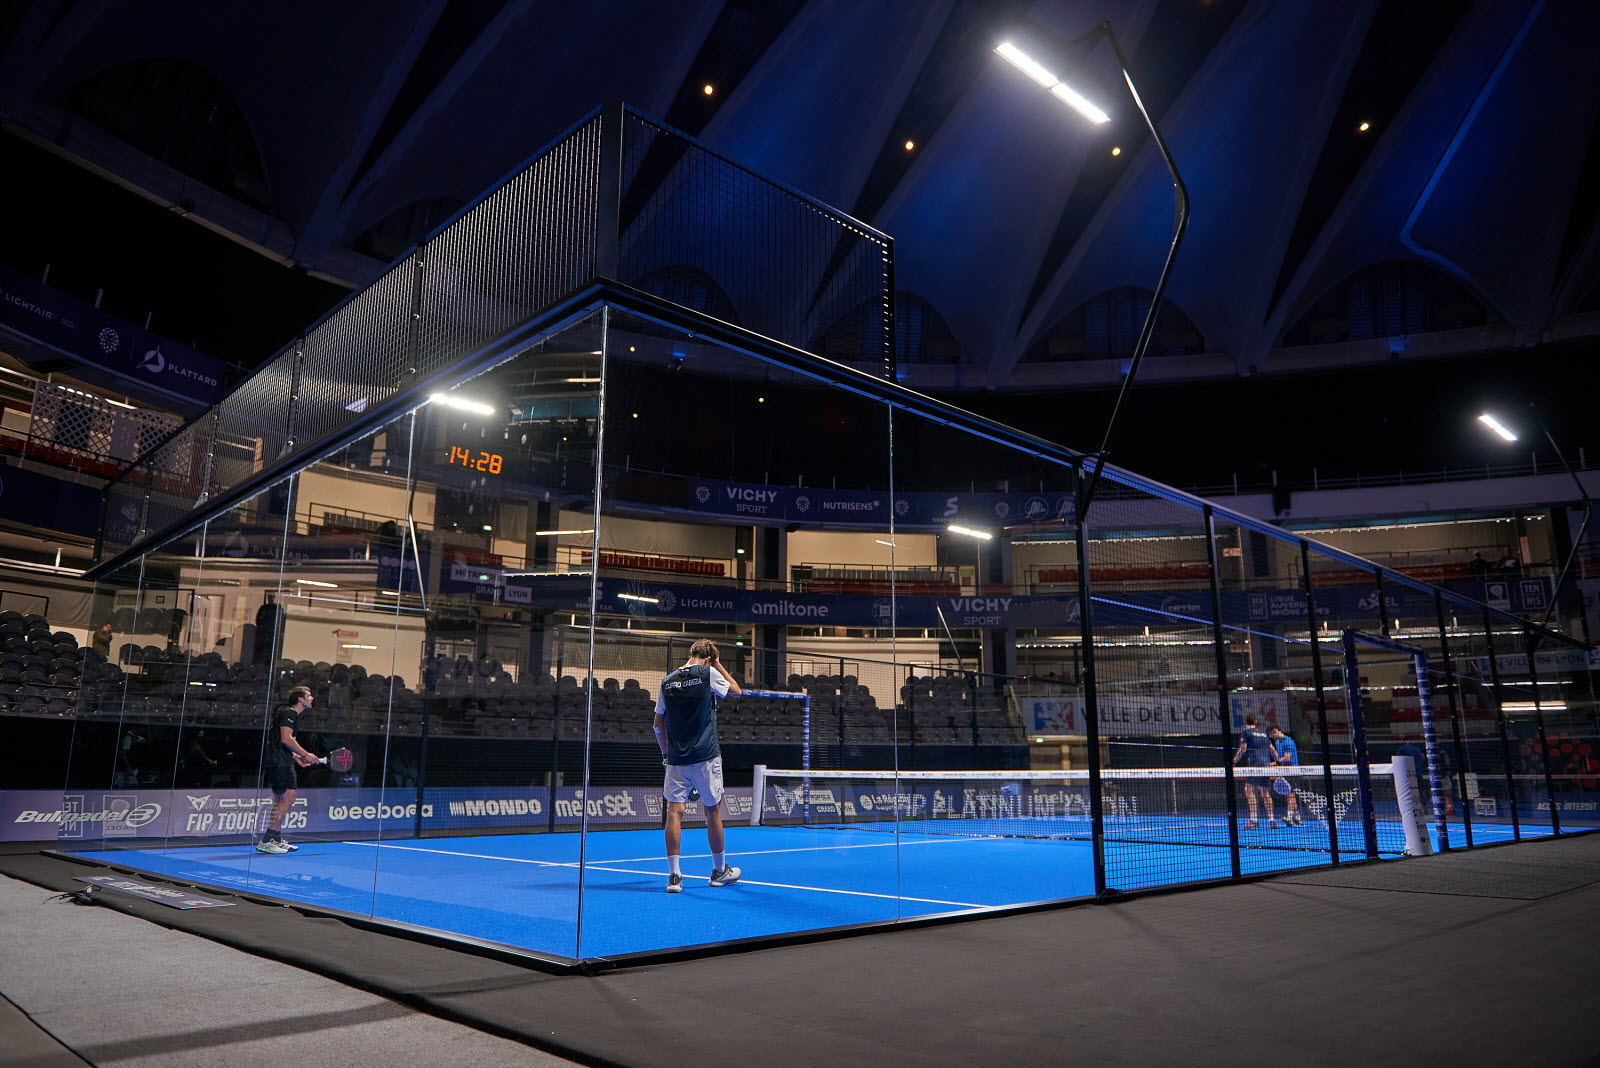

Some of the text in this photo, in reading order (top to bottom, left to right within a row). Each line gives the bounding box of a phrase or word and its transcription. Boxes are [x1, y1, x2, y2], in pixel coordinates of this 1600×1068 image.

[5, 293, 53, 319] LIGHTAIR
[168, 363, 217, 387] PLATTARD
[450, 446, 503, 475] 14:28
[726, 486, 778, 503] VICHY
[736, 503, 768, 514] SPORT
[508, 589, 528, 599] LYON
[1523, 584, 1540, 593] TEN
[680, 598, 734, 611] LIGHTAIR
[751, 600, 830, 617] amiltone
[950, 597, 1014, 612] VICHY
[963, 615, 1002, 626] SPORT
[1506, 657, 1531, 667] VILL
[1138, 706, 1162, 722] DE
[219, 797, 308, 808] CUPA
[464, 798, 542, 816] MONDO
[14, 810, 129, 826] Bullpadel
[186, 811, 308, 832] FIP TOUR 025
